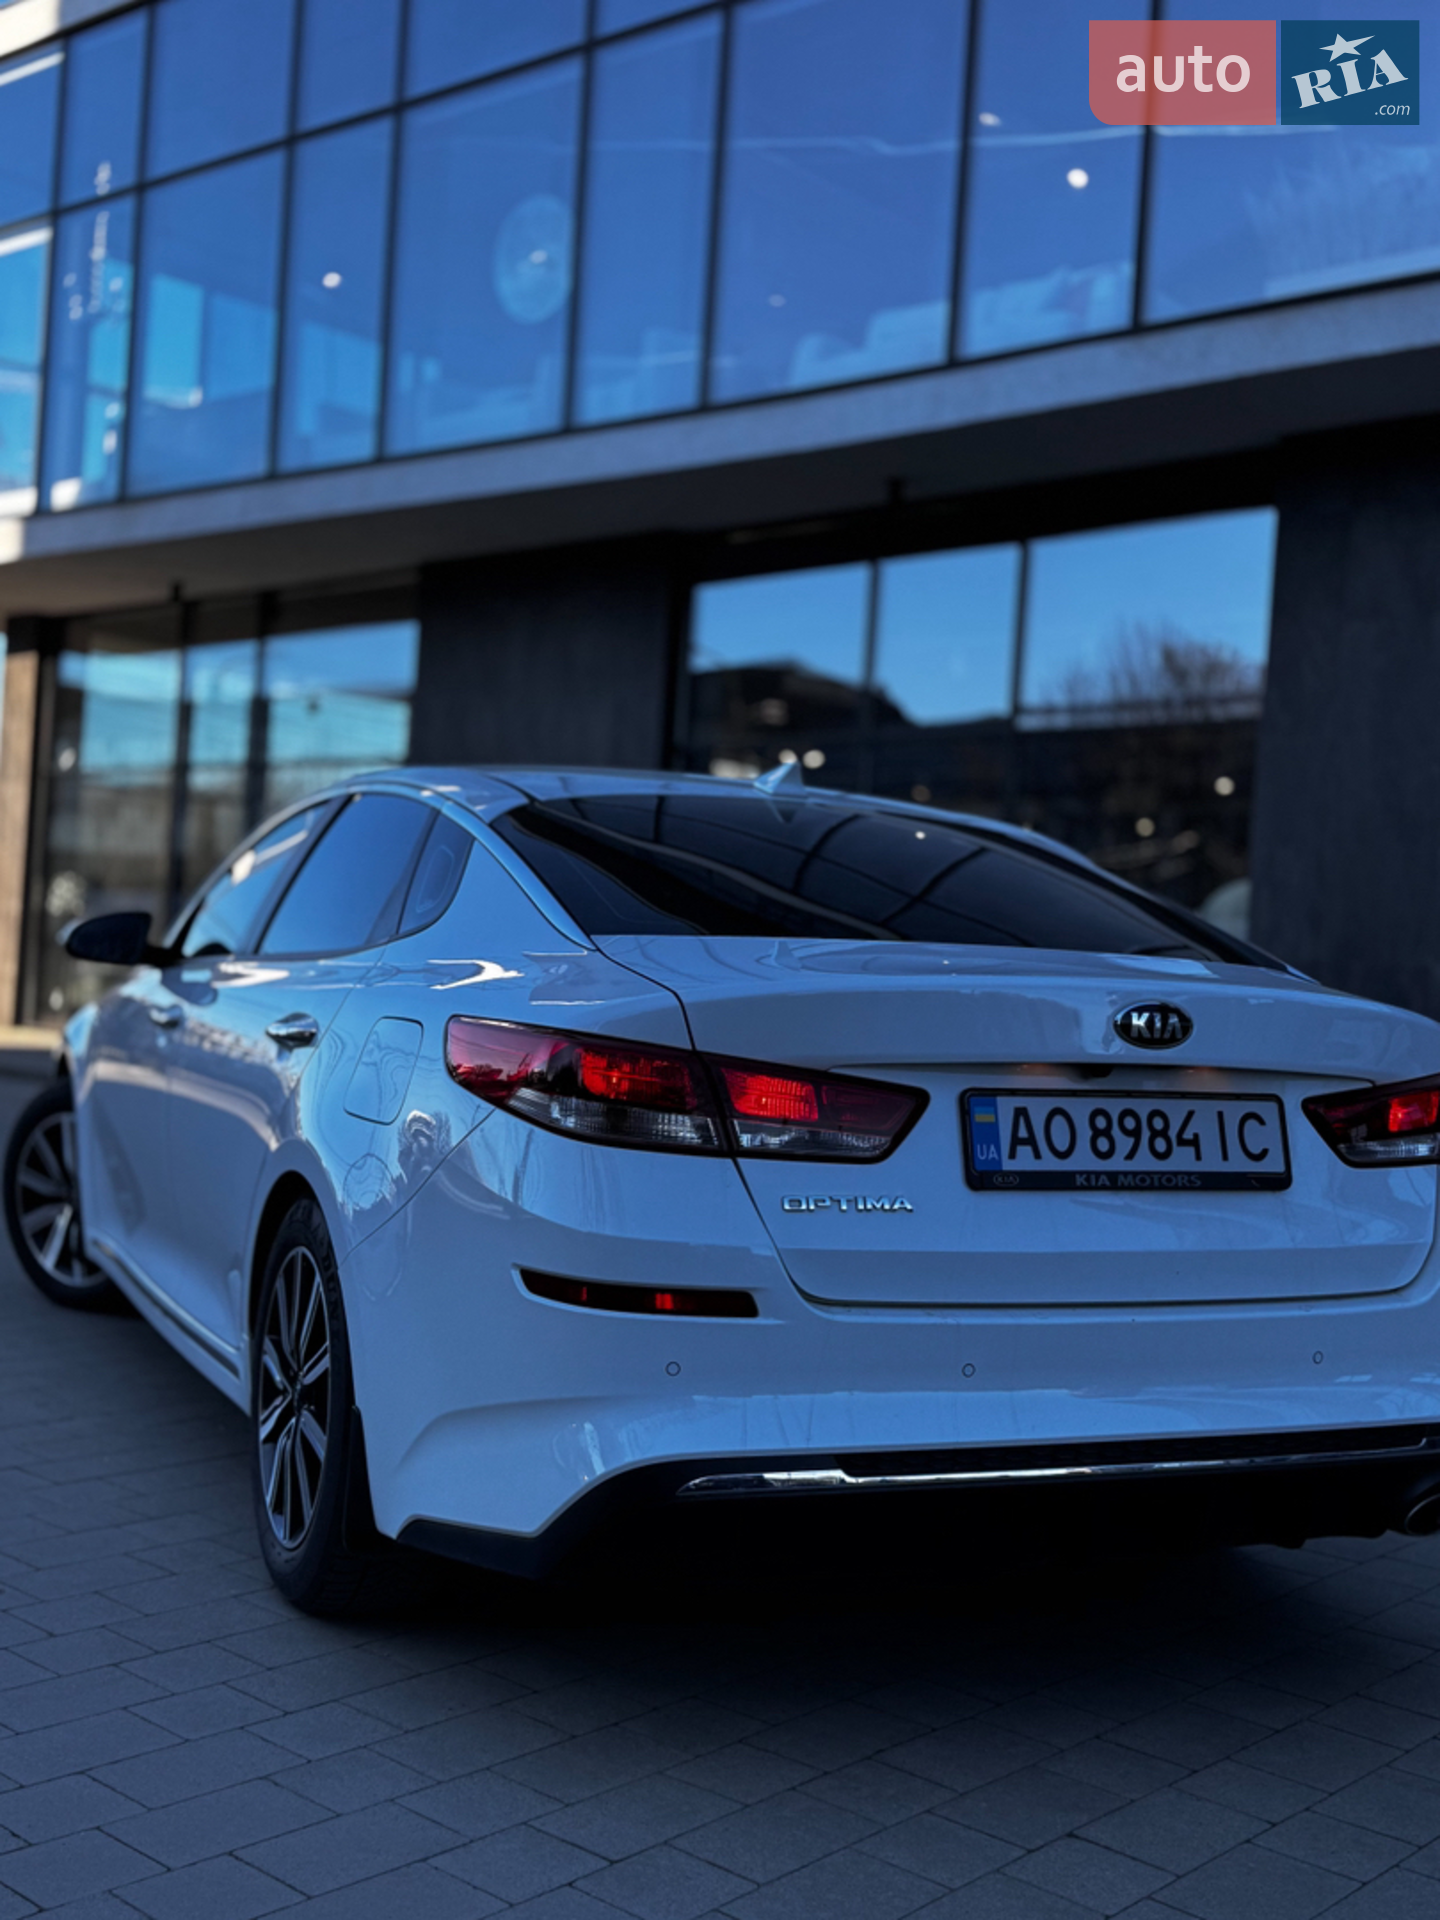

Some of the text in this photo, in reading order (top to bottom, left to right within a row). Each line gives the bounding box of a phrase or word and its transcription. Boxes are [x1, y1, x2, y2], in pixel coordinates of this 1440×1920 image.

[1129, 1011, 1184, 1039] KIA
[1007, 1106, 1270, 1162] AO 8984 IC
[976, 1143, 1000, 1162] UA
[1074, 1173, 1202, 1188] KIA MOTORS
[781, 1195, 914, 1213] OPTIMA
